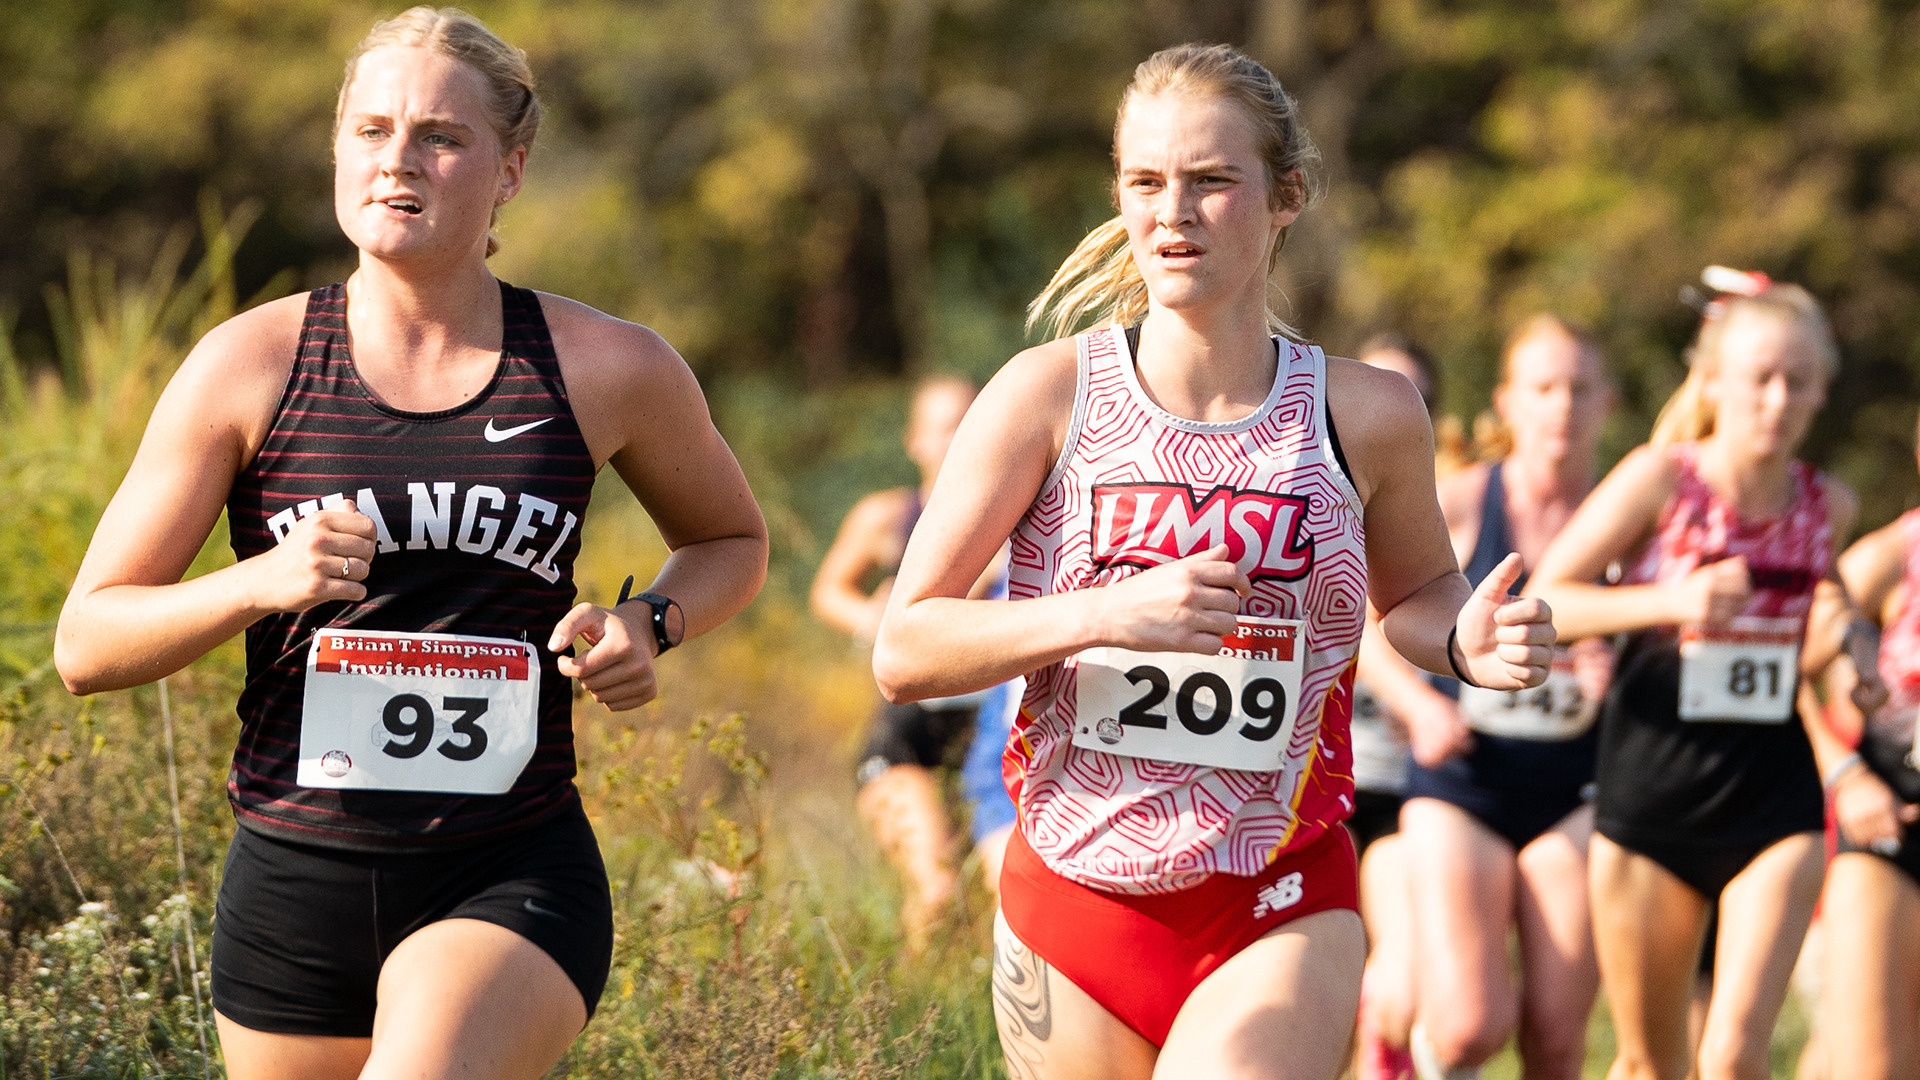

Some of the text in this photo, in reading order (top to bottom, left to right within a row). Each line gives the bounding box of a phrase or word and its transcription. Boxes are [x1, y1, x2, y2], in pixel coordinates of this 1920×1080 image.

[1095, 490, 1307, 579] UMSL
[330, 637, 518, 658] Brian T. Simpson
[338, 659, 509, 681] Invitational
[1119, 665, 1287, 742] 209
[1728, 657, 1780, 699] 81
[382, 693, 489, 761] 93
